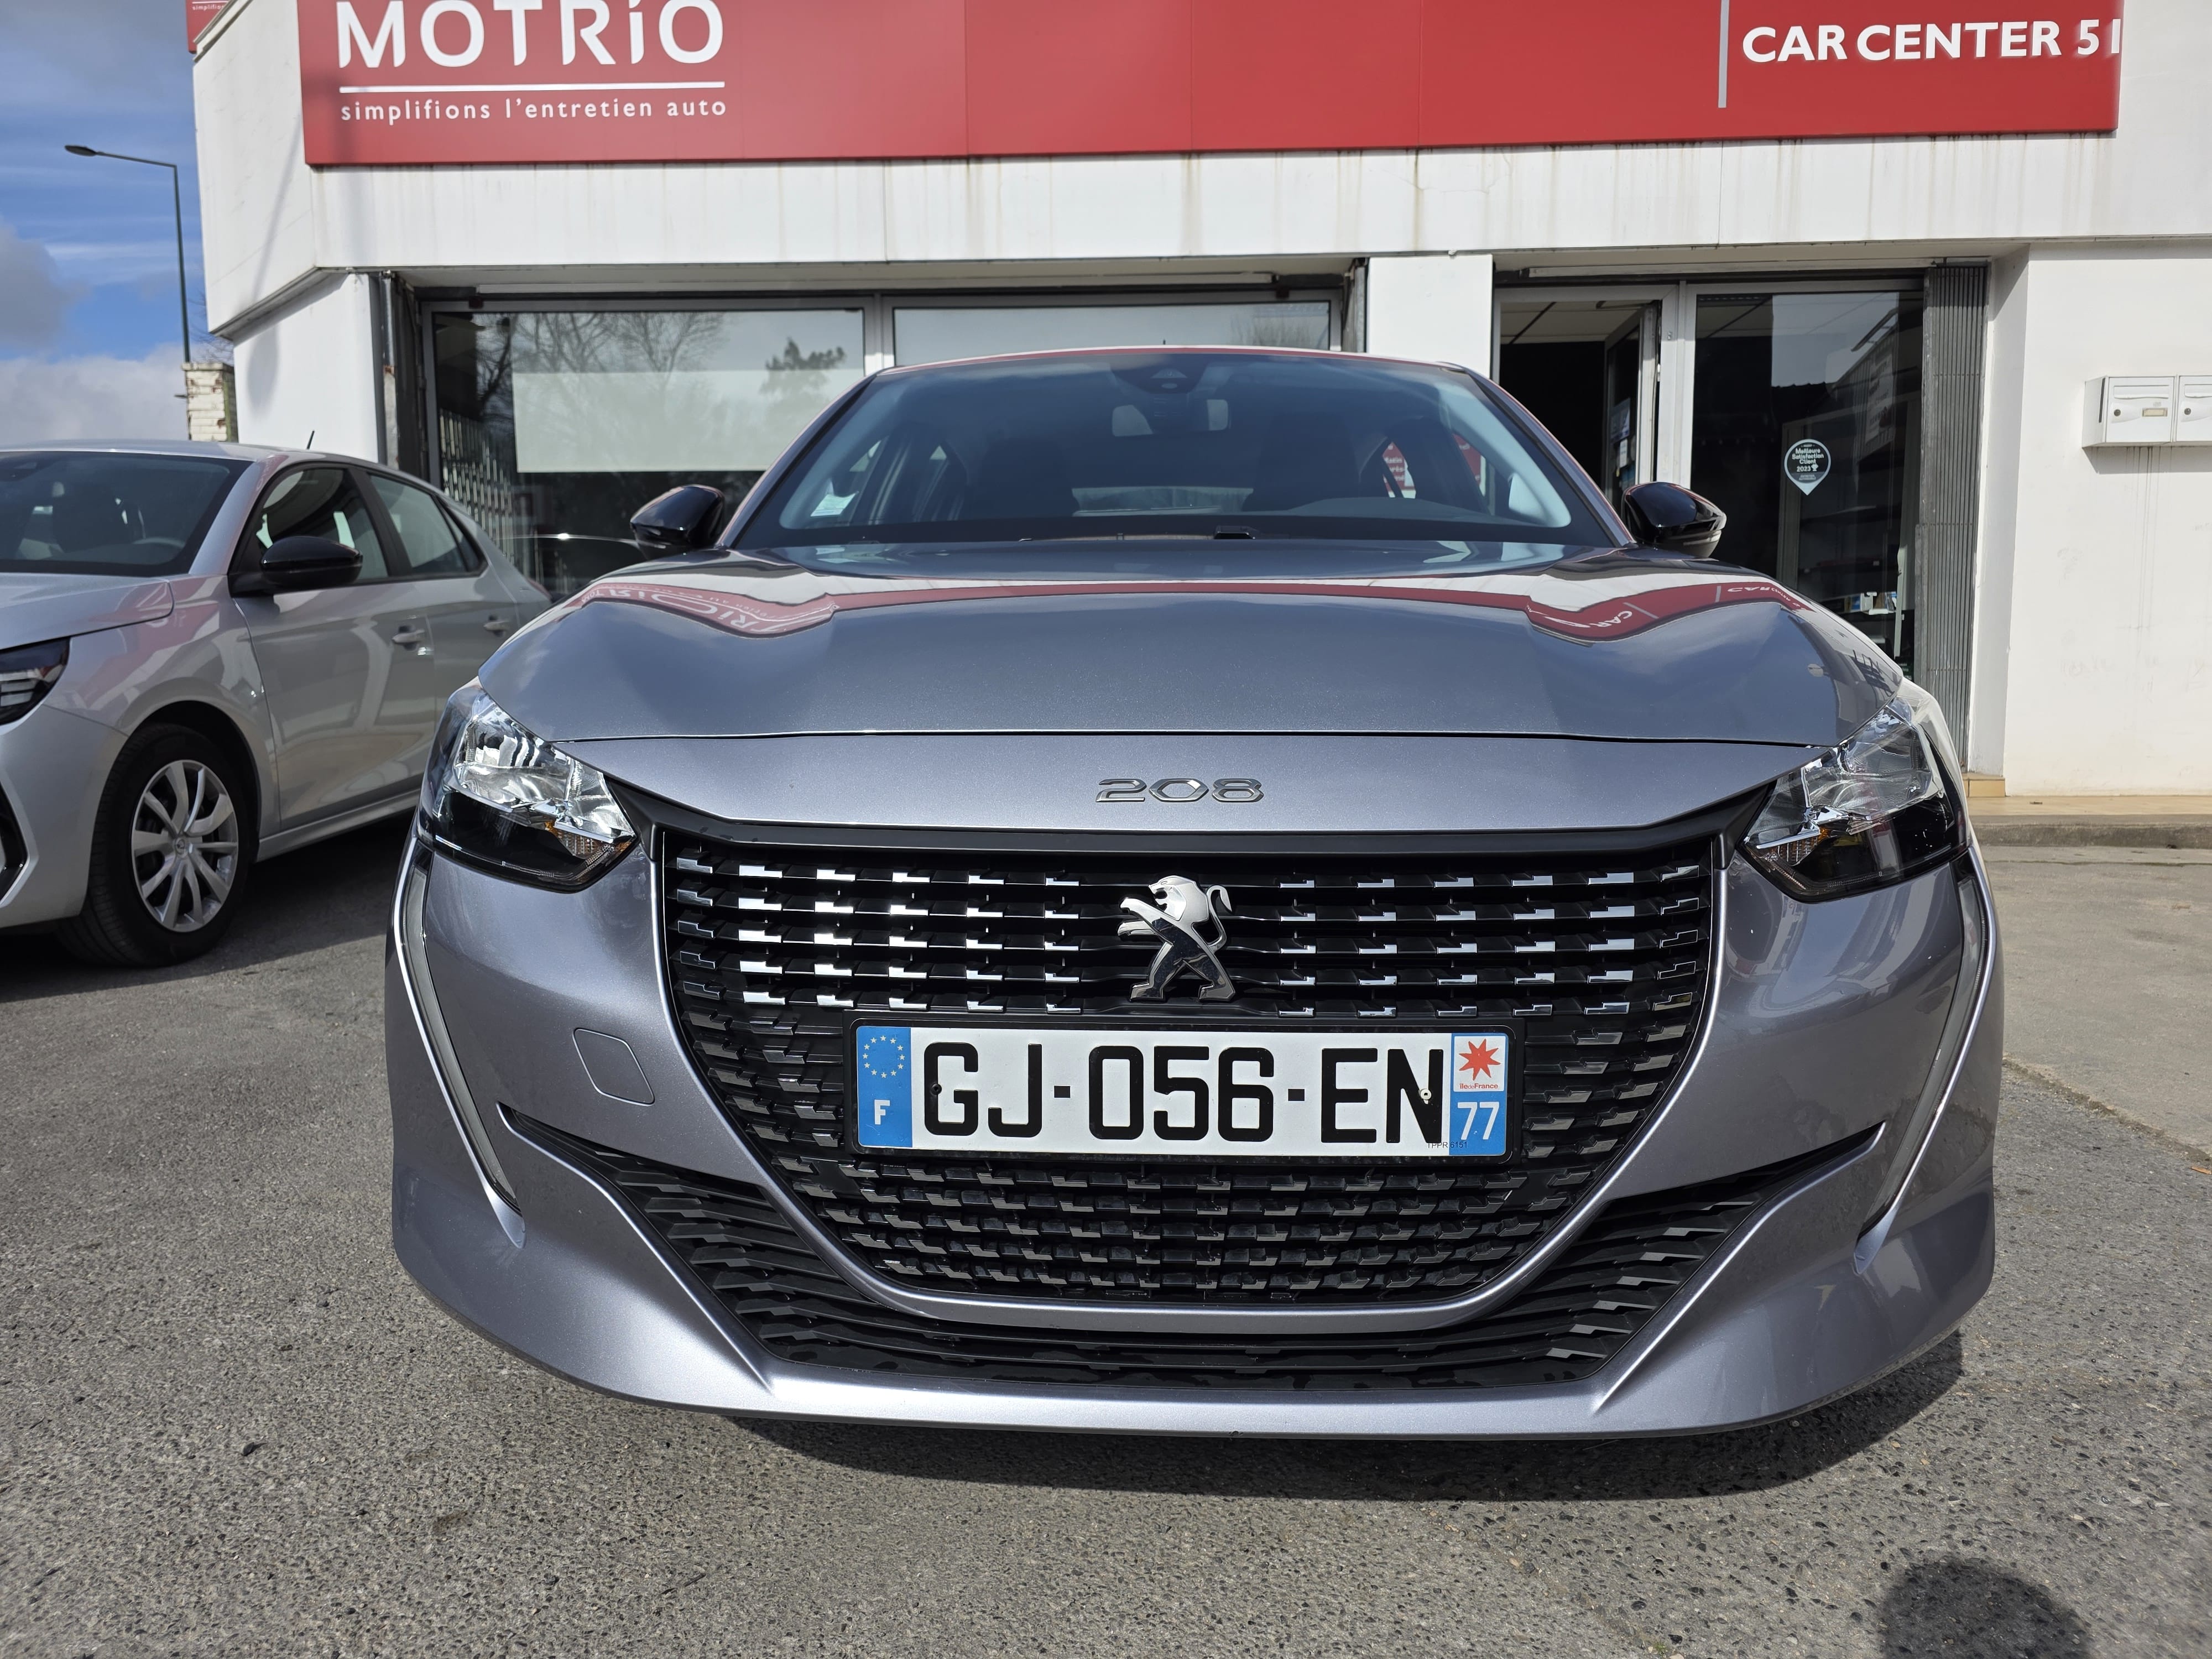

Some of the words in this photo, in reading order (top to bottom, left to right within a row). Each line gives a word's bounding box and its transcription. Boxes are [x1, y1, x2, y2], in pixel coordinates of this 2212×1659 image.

[1743, 24, 1848, 63] CAR
[1856, 20, 2062, 61] CENTER
[341, 100, 491, 126] simplifions
[666, 99, 726, 117] auto
[1095, 778, 1264, 802] 208
[874, 1099, 890, 1125] F
[1457, 1102, 1500, 1140] 77
